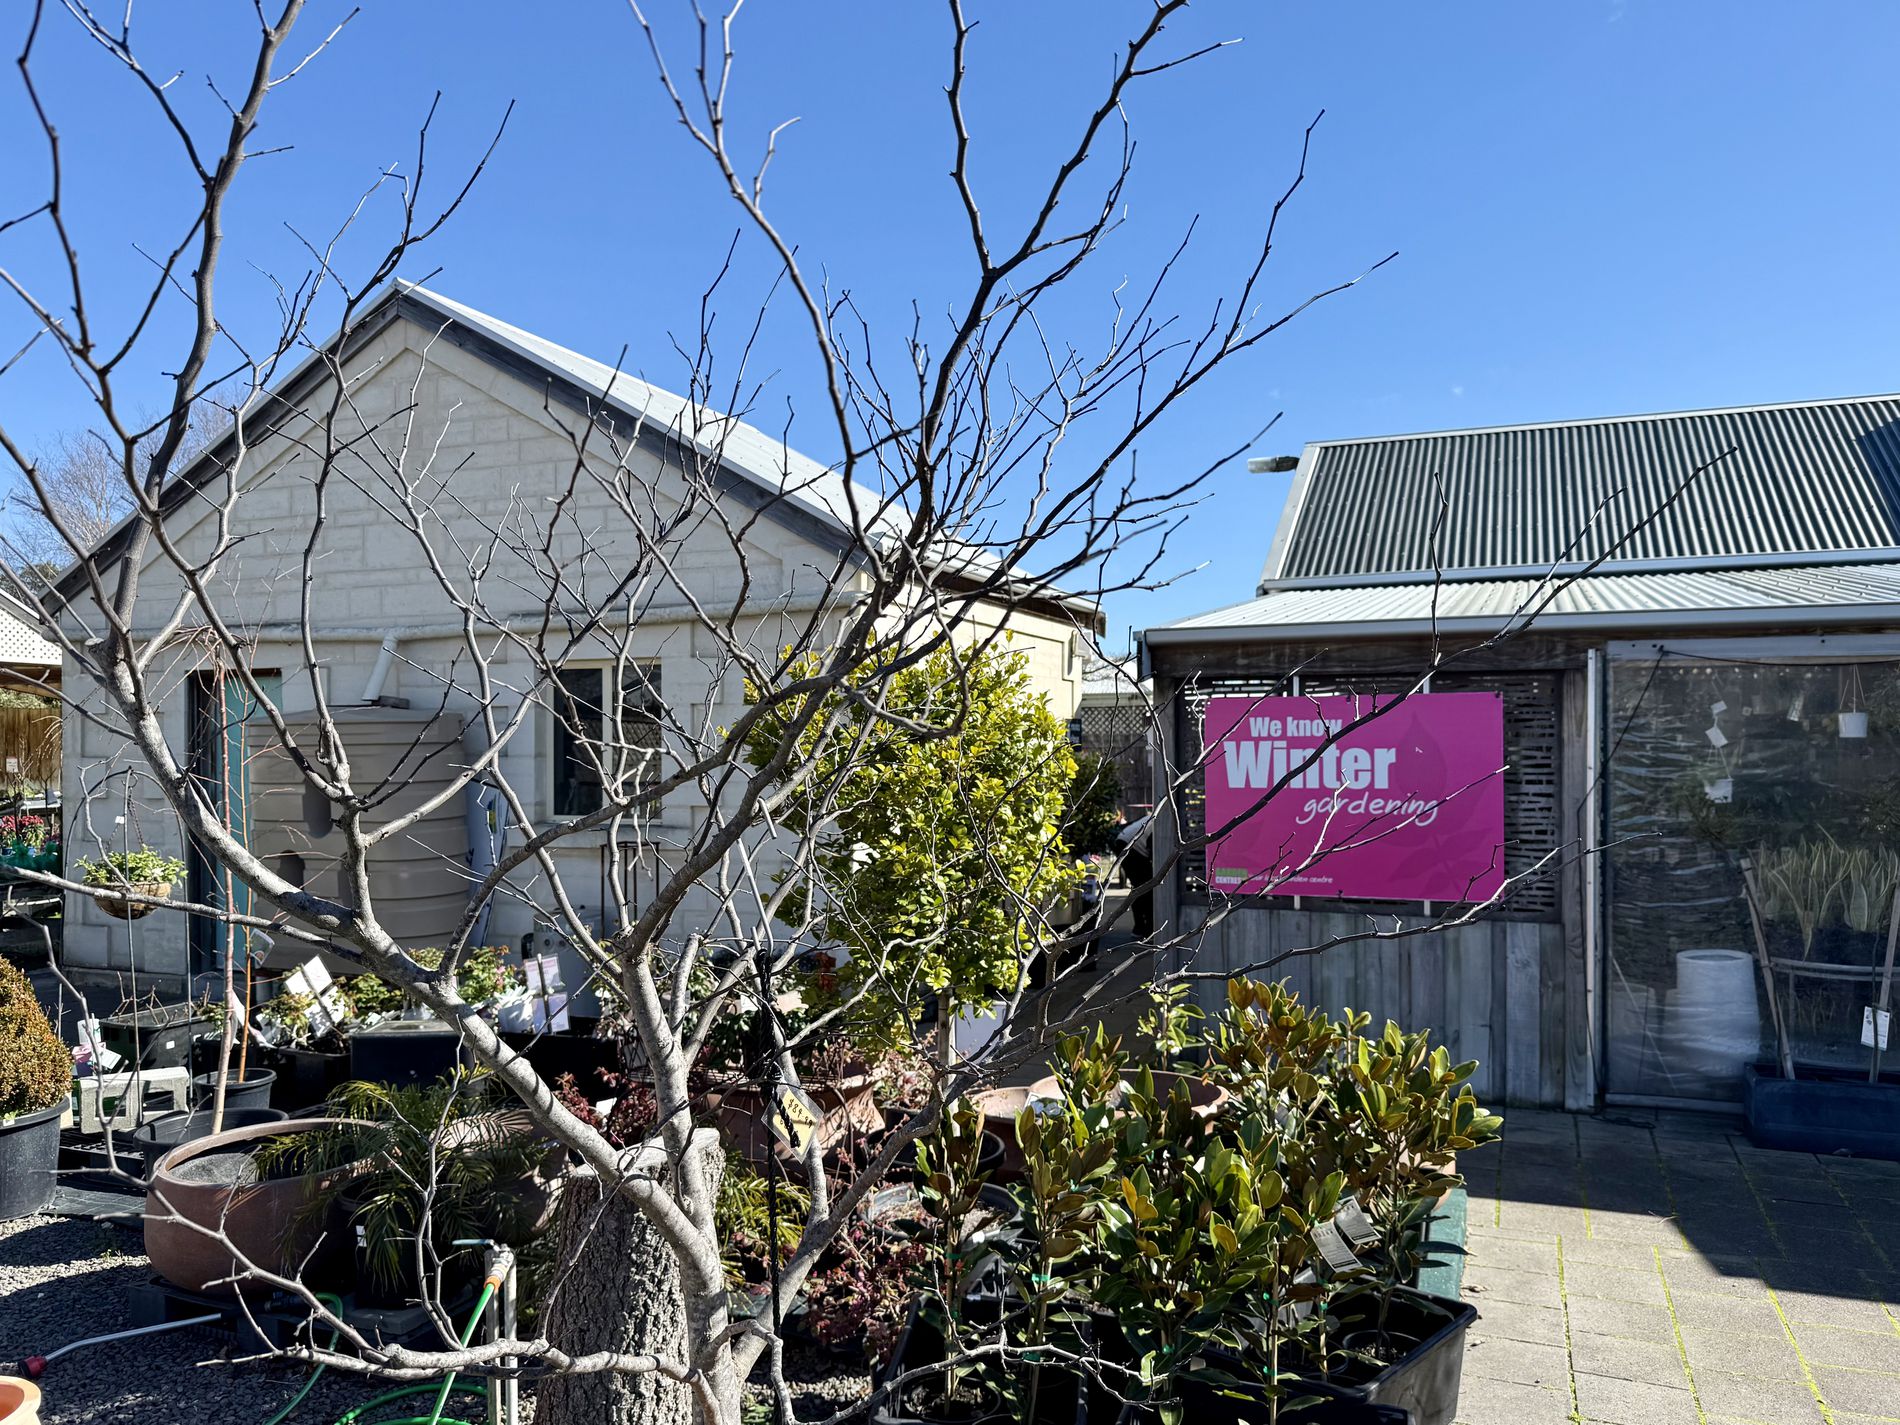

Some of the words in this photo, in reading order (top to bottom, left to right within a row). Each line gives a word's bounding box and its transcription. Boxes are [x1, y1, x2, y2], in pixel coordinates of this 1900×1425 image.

[1249, 717, 1282, 737] We
[1286, 716, 1343, 737] know
[1223, 740, 1397, 789] Winter
[1295, 791, 1438, 827] gardening
